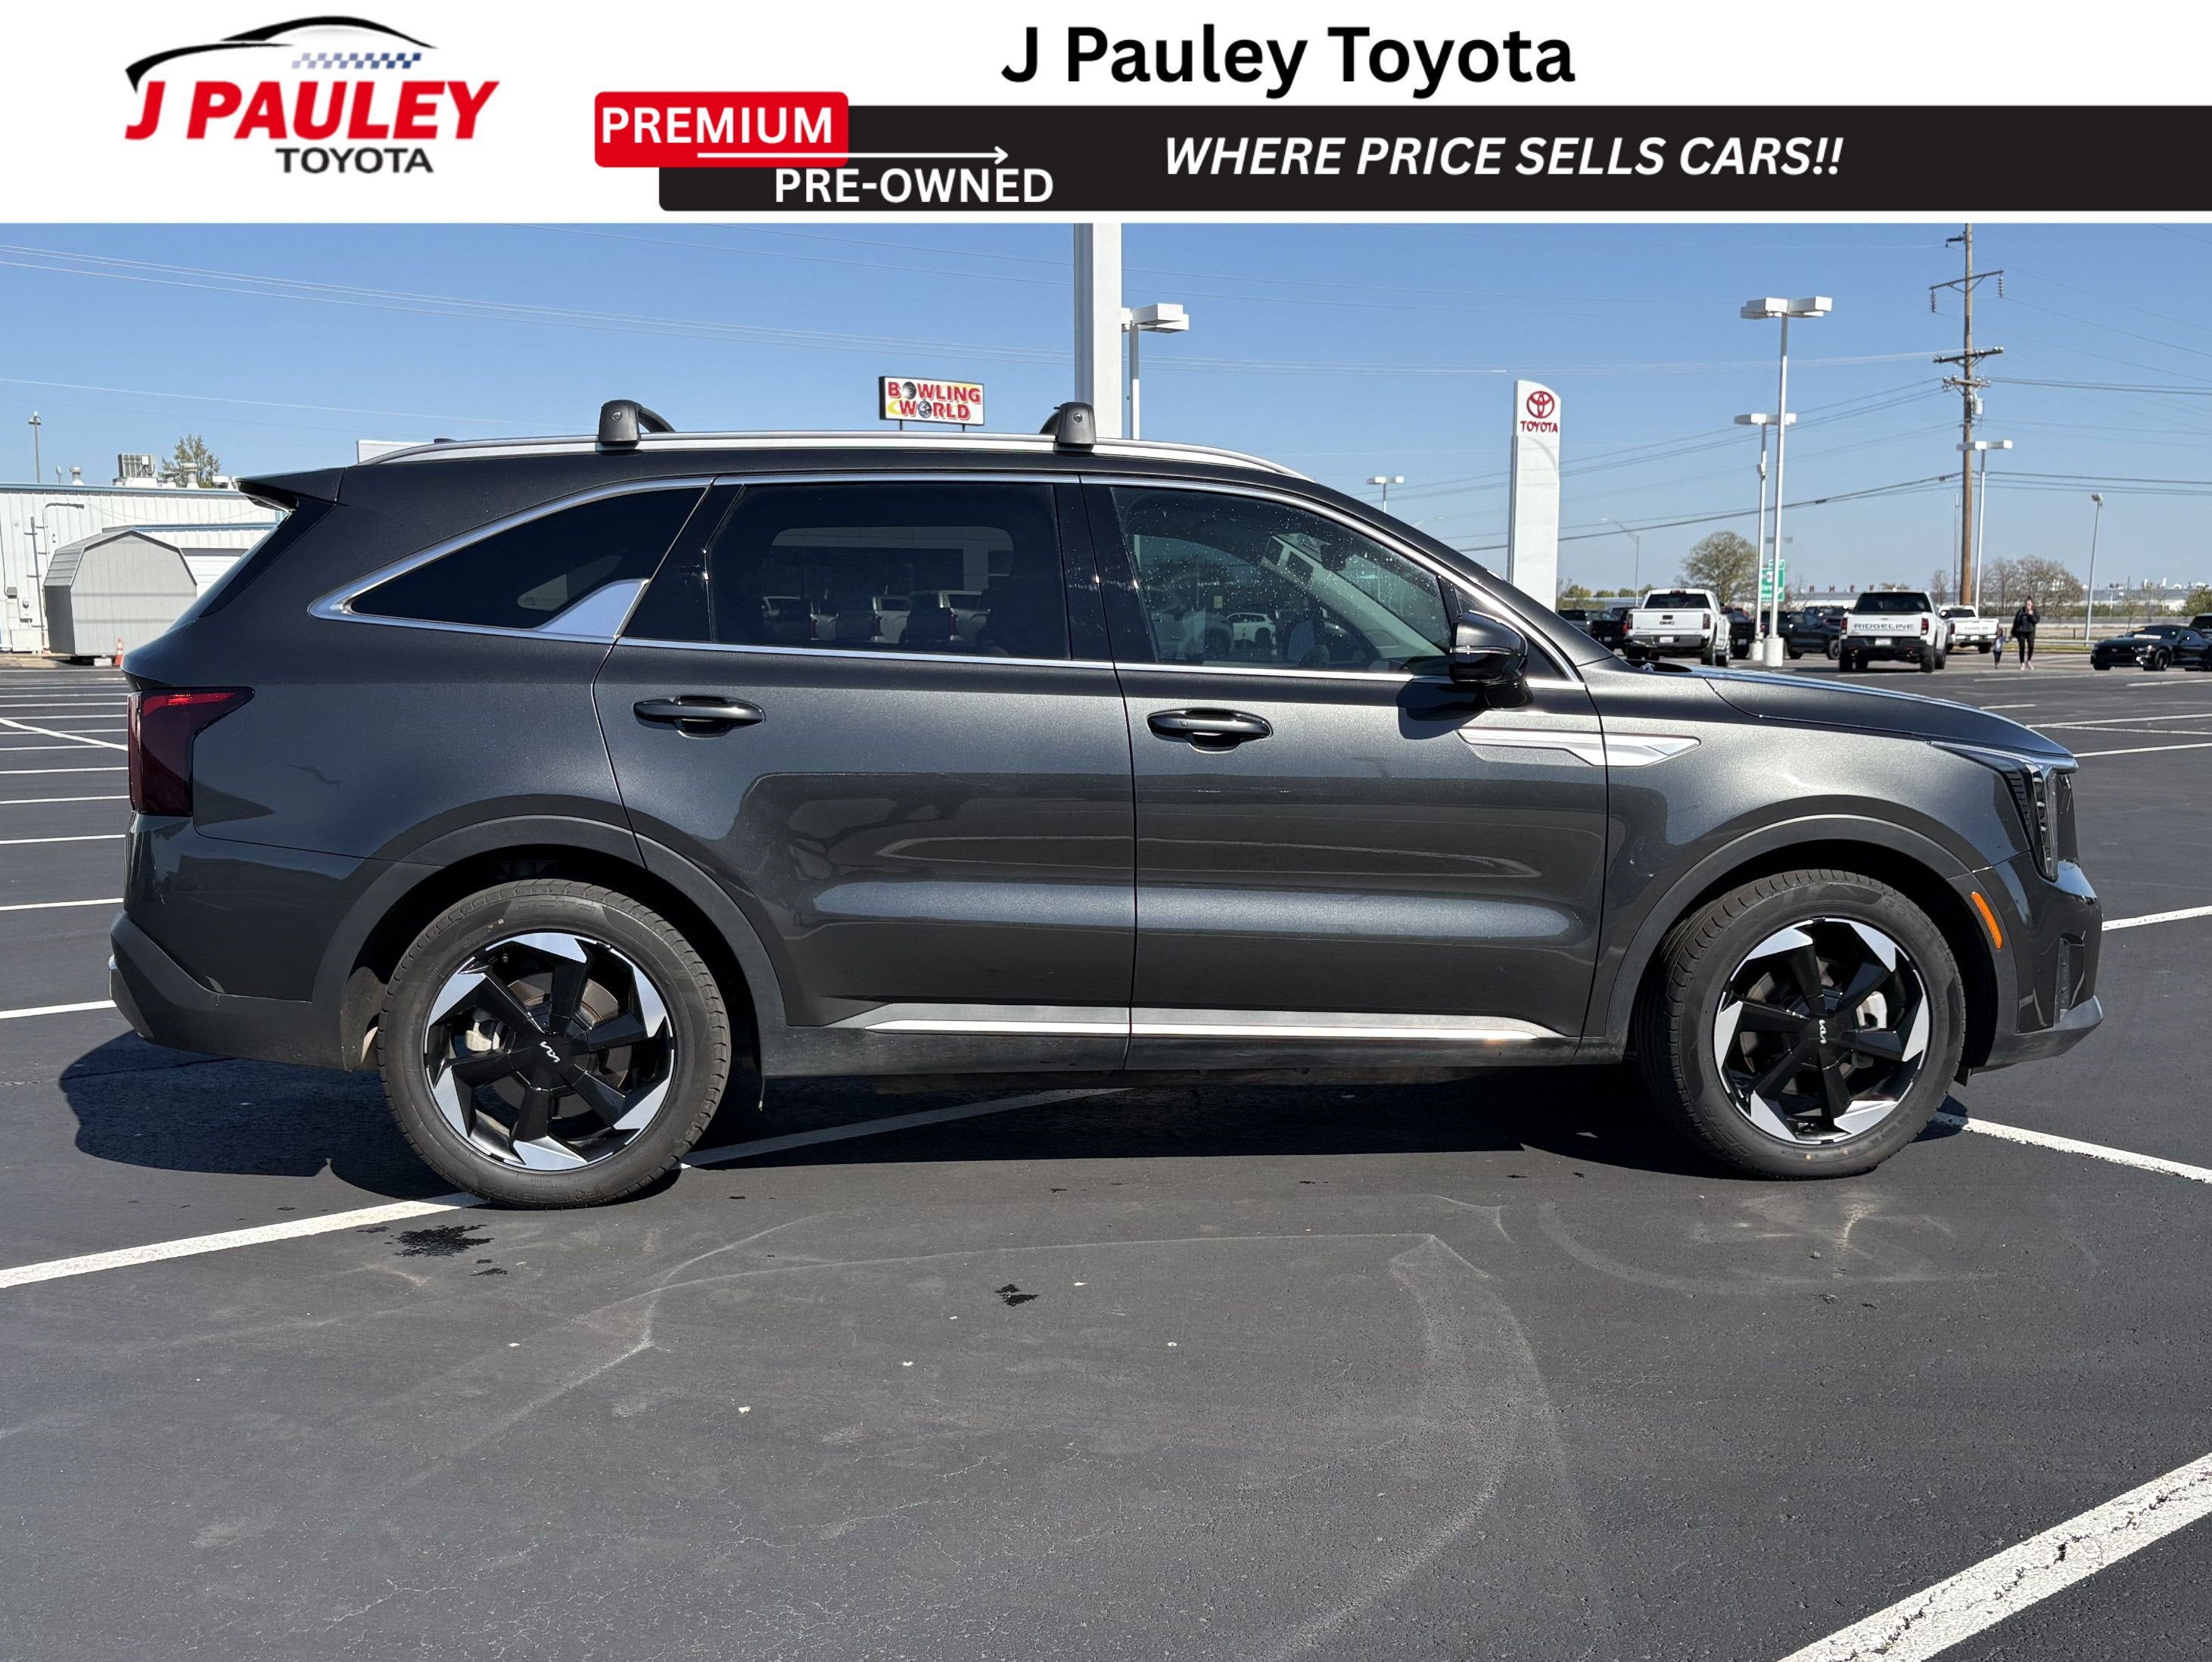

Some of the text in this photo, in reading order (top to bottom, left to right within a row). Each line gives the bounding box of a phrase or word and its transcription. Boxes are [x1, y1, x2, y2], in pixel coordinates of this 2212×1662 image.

[888, 381, 982, 404] BOWLING
[898, 400, 971, 420] WORLD
[1520, 420, 1558, 434] TOYOTA
